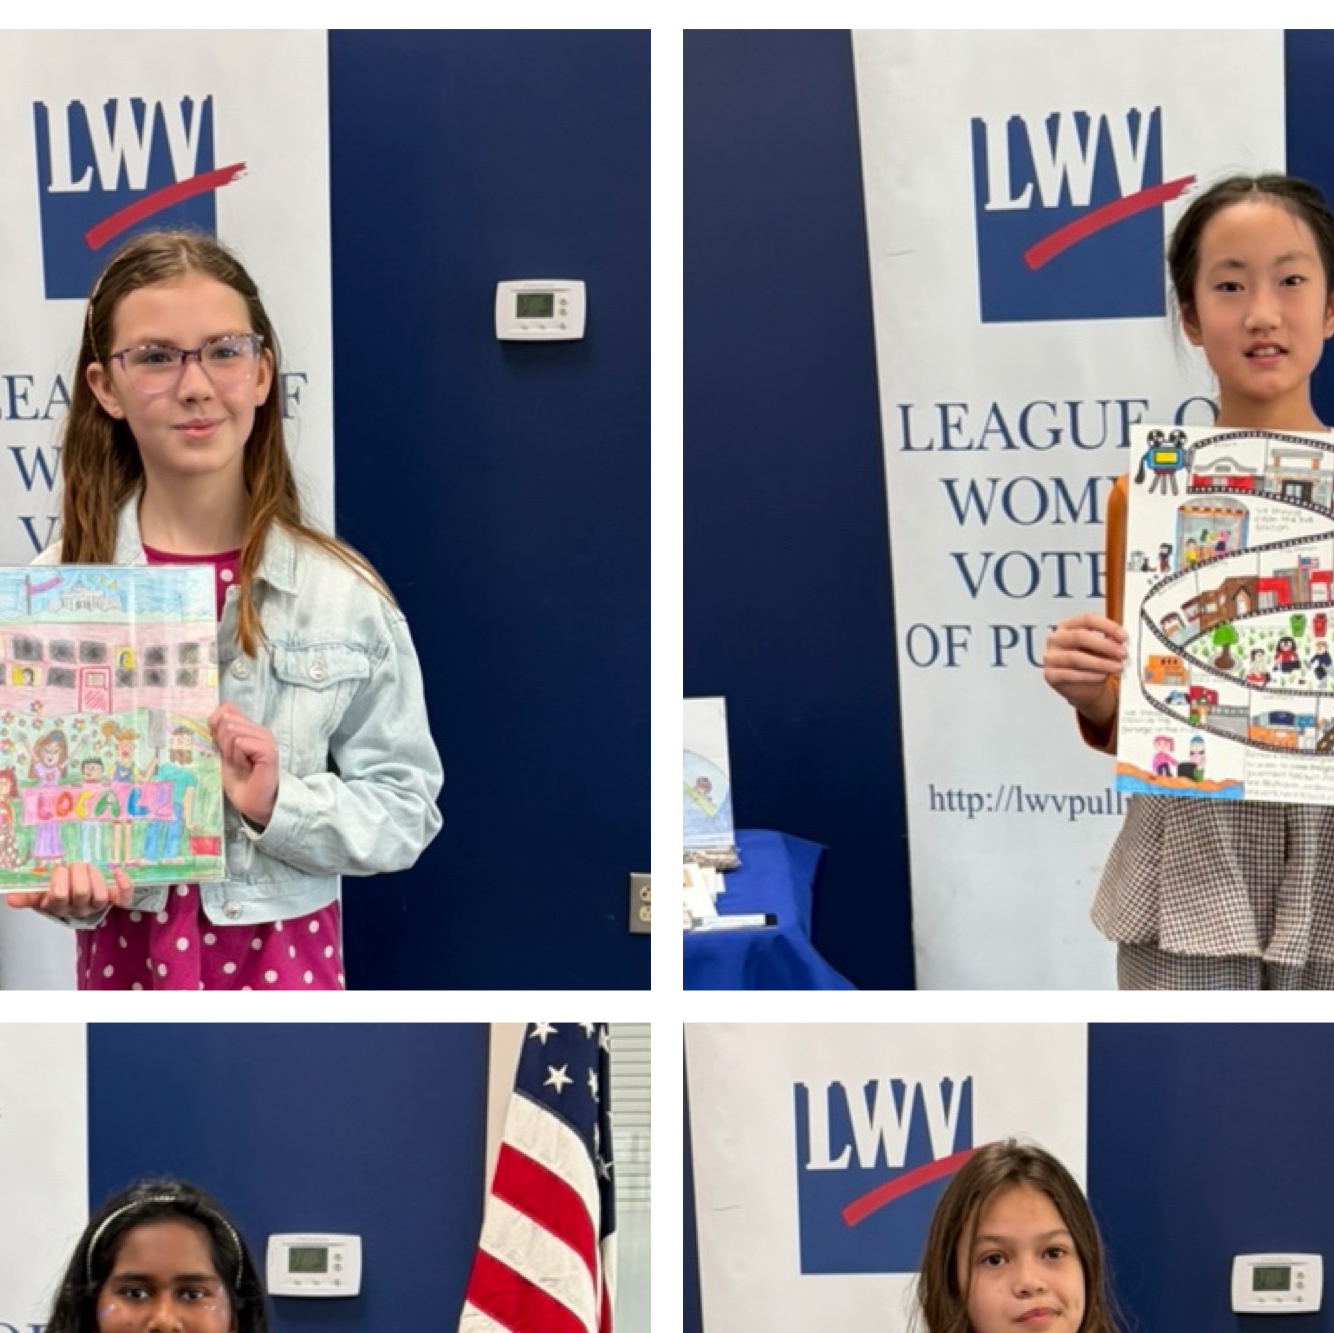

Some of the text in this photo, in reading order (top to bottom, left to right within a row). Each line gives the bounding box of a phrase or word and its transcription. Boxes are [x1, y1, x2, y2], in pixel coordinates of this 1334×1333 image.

[37, 95, 213, 192] LWV
[976, 106, 1160, 210] LWV
[941, 476, 1101, 526] WOM
[954, 551, 1106, 599] VOTE
[906, 624, 971, 667] OF
[797, 1077, 971, 1170] LWV
